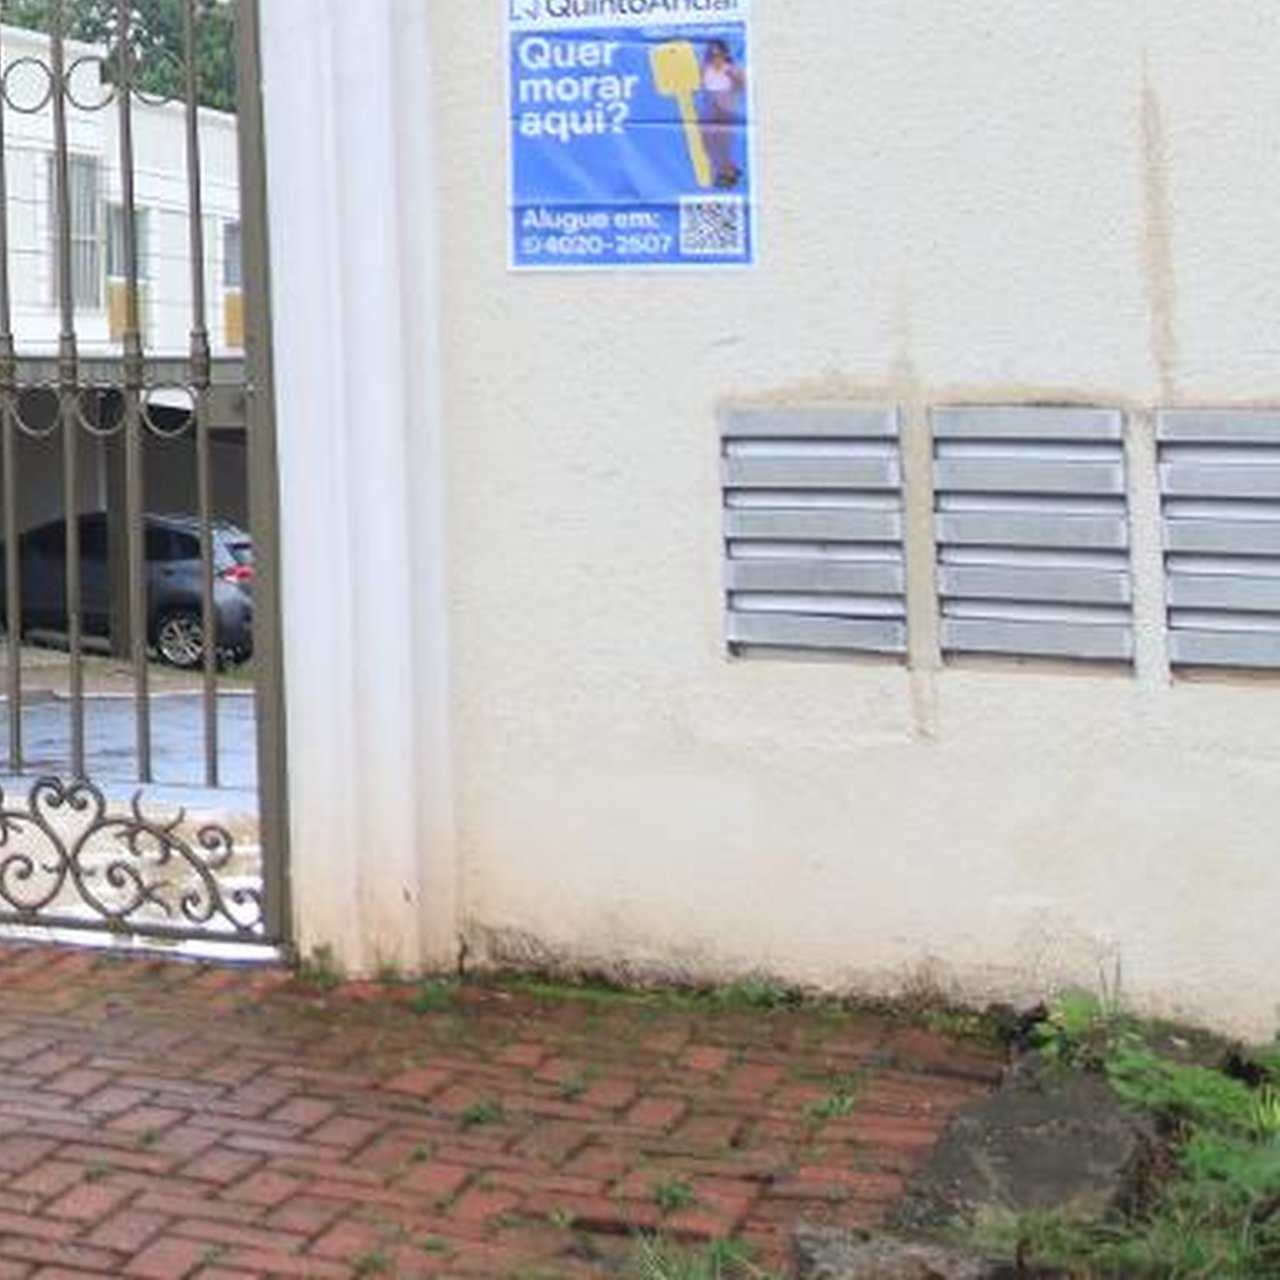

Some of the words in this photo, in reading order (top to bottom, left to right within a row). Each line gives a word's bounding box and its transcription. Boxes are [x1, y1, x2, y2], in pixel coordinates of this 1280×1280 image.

[518, 38, 619, 69] Quer
[519, 73, 638, 102] morar
[519, 102, 629, 143] aqui?
[523, 209, 608, 232] Alugue
[614, 212, 659, 229] em:
[546, 235, 672, 254] 4020-2507
